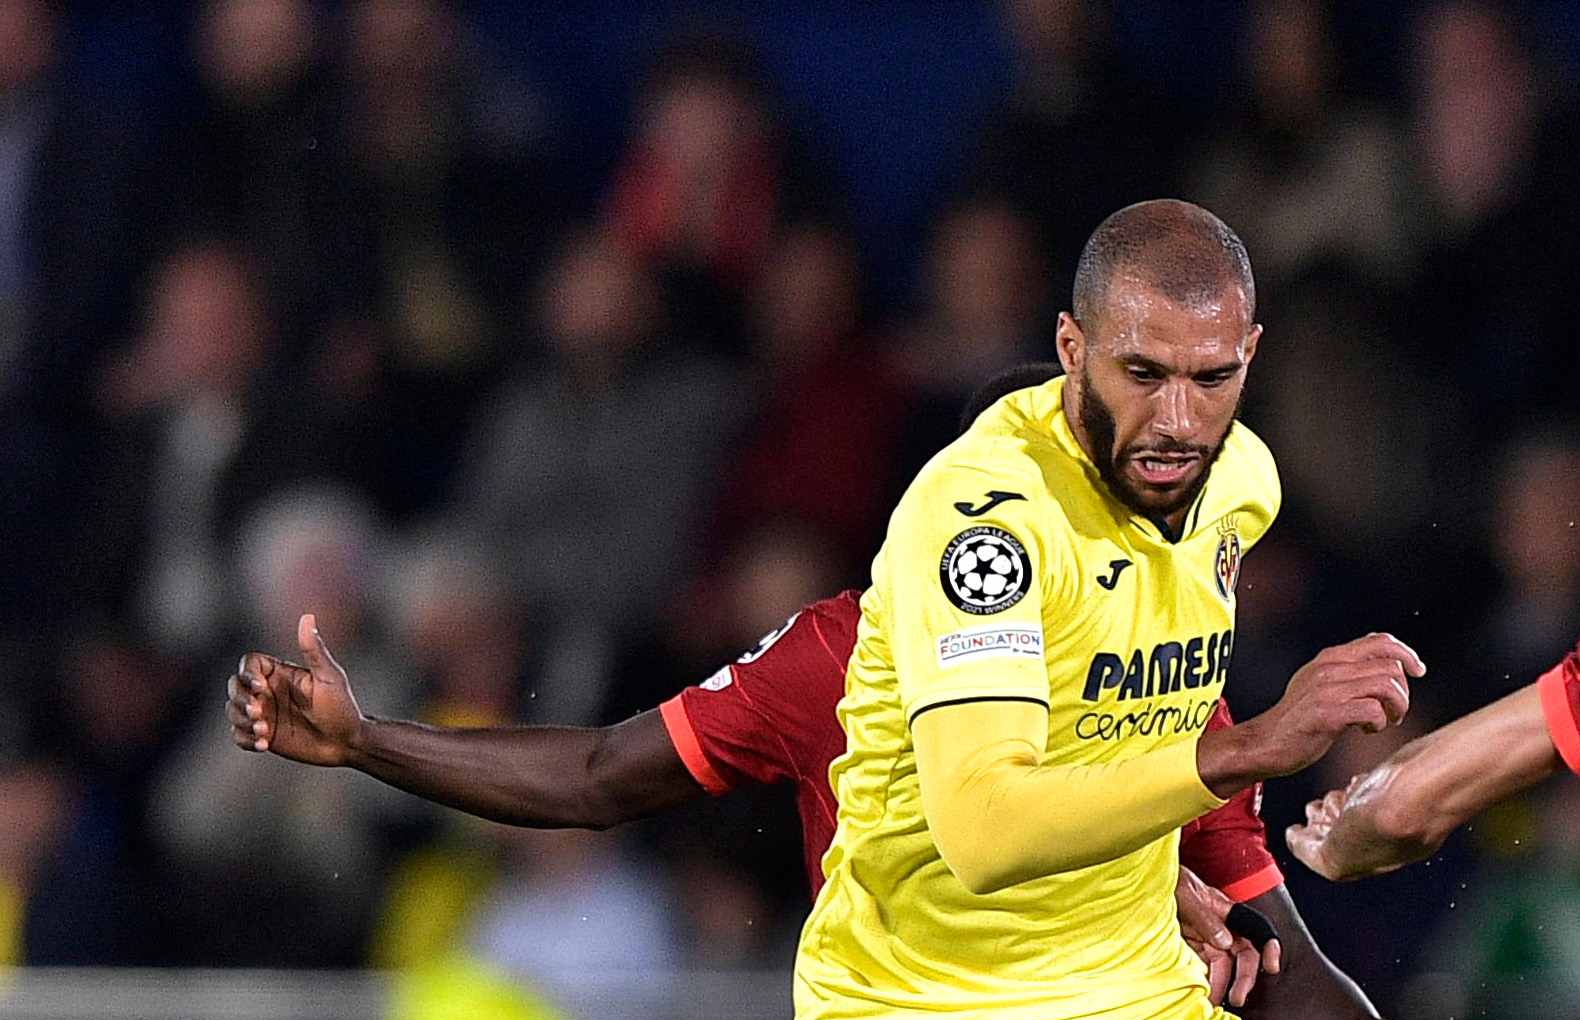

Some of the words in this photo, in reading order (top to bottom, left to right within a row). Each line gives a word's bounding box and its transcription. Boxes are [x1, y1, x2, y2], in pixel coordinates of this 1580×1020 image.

[952, 527, 990, 547] EUROPA
[992, 528, 1025, 556] LEAGUE
[940, 633, 1040, 657] FOUNDATION
[1081, 629, 1232, 701] PAMESA
